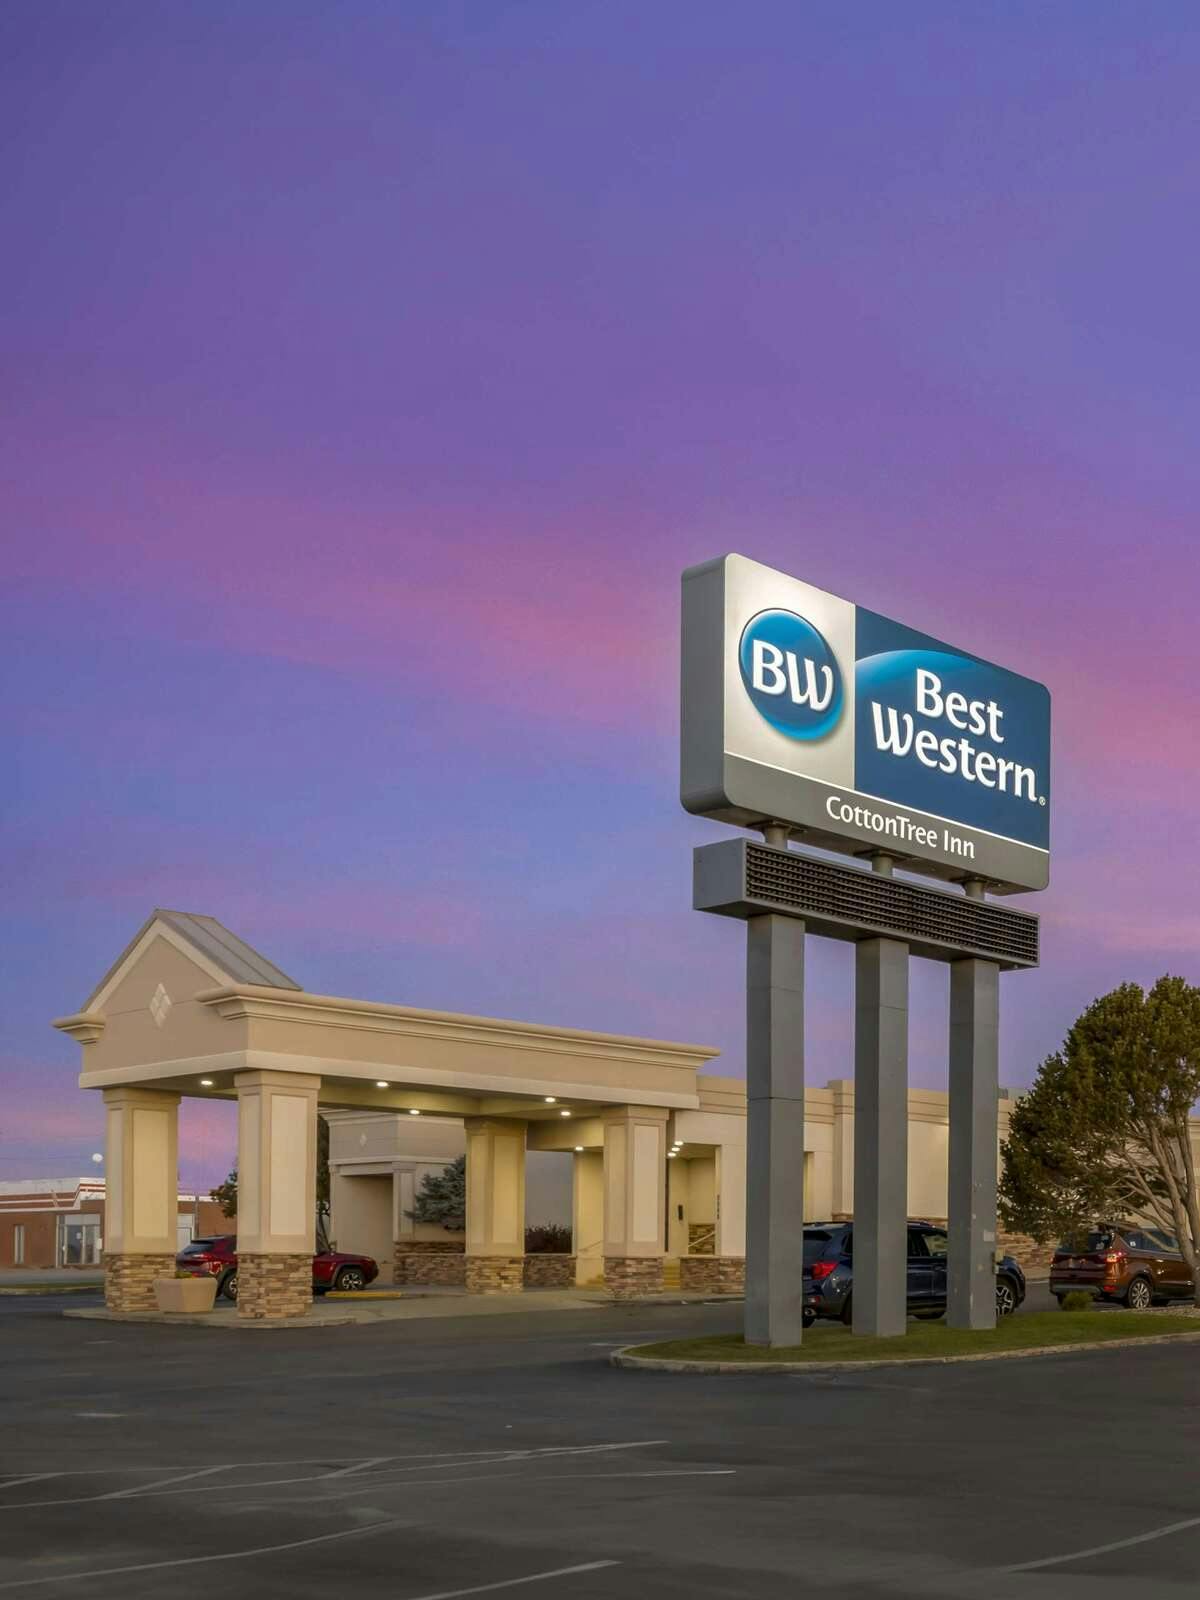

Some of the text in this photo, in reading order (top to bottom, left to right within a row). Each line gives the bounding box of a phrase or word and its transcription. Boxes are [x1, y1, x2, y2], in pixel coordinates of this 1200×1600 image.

[752, 639, 834, 712] BW
[916, 668, 1004, 743] Best
[826, 796, 976, 859] CottonTree Inn
